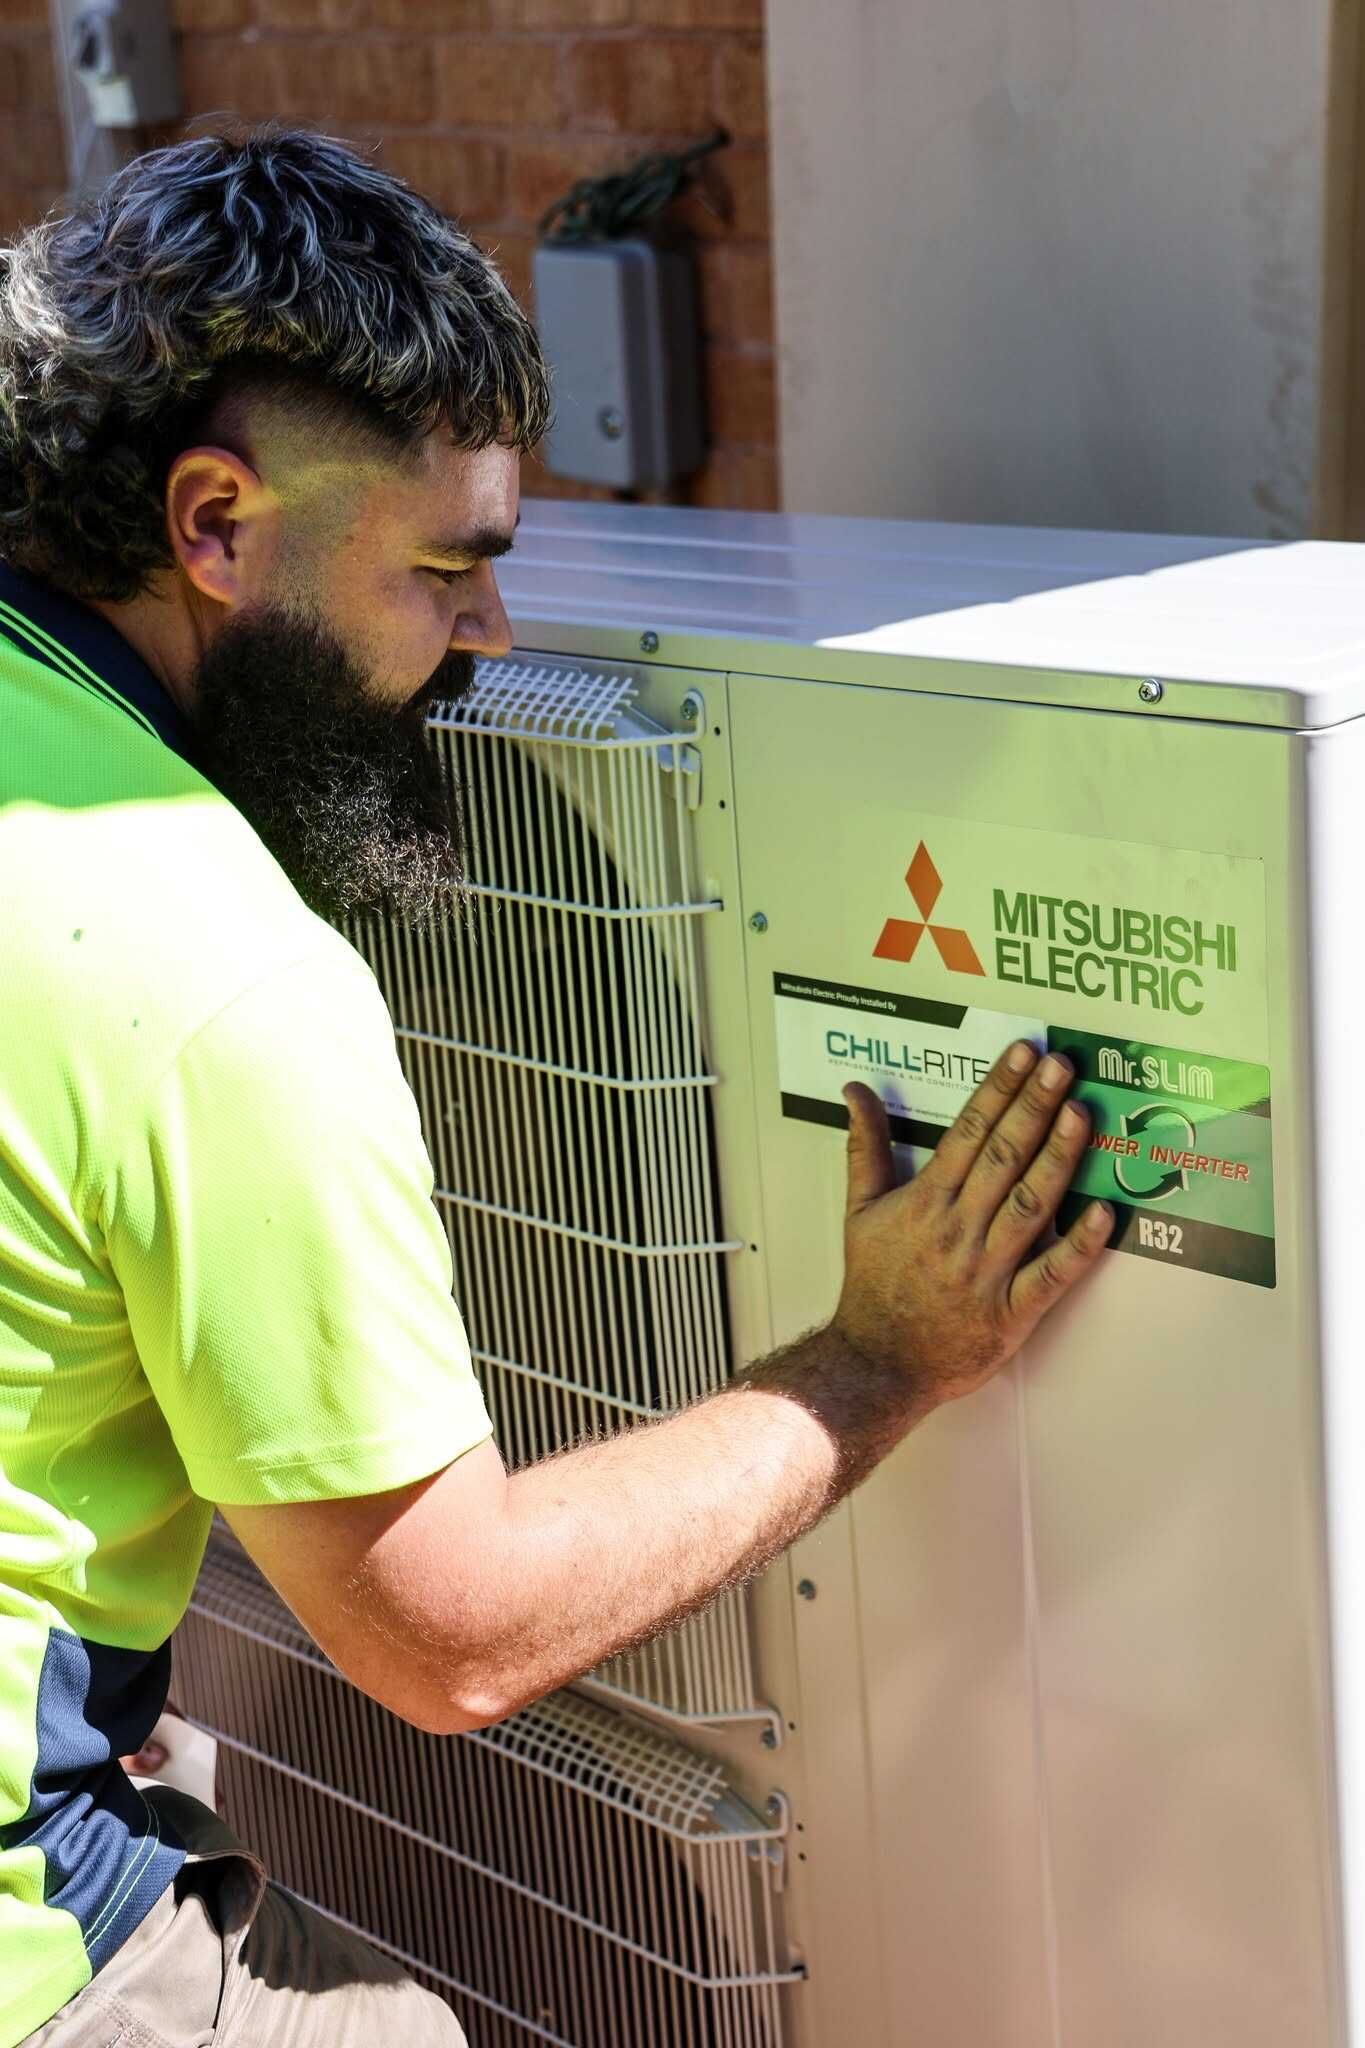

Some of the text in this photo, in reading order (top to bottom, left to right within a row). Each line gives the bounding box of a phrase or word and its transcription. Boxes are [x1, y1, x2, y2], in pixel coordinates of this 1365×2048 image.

[993, 888, 1236, 972] MITSUBISHI
[780, 981, 897, 1012] Mitsubishi Electric Proudly Installed By
[996, 937, 1204, 1016] ELECTRIC
[826, 1030, 991, 1085] CHILL-RITE
[1088, 1133, 1249, 1183] WER INVERTER
[1139, 1217, 1183, 1254] R32
